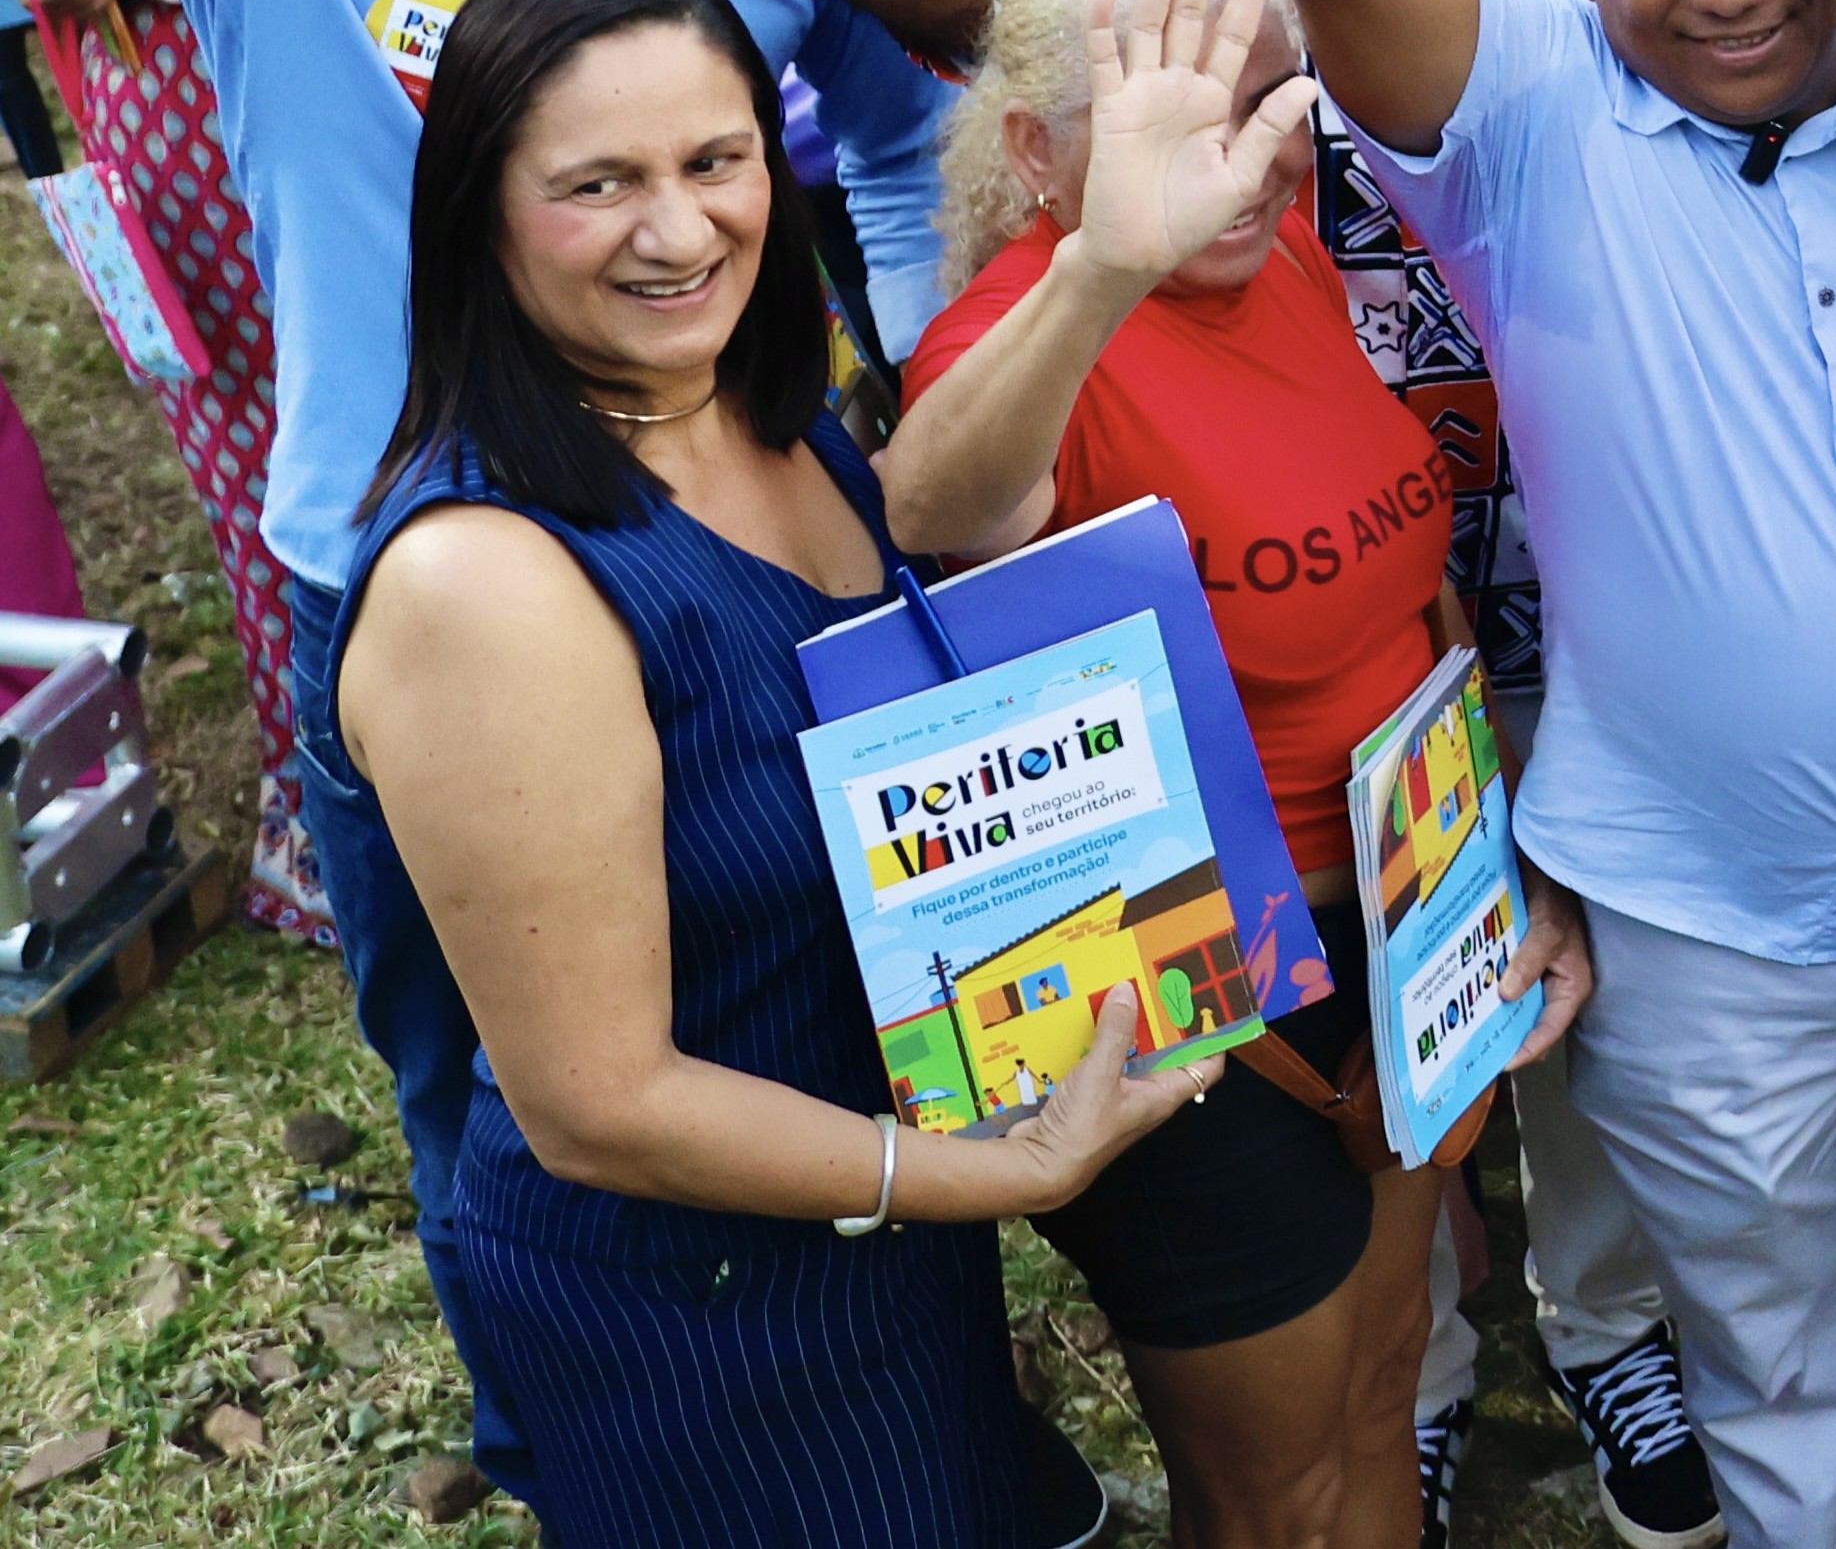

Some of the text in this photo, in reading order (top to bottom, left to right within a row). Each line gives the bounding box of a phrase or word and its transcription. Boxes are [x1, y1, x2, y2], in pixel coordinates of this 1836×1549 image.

[399, 30, 440, 62] Viv
[1196, 452, 1452, 593] LOS ANGE
[877, 717, 1125, 833] Periferia
[1022, 779, 1106, 819] chegou ao
[1025, 786, 1137, 836] seu território:
[888, 810, 1017, 880] Viva
[911, 828, 1128, 919] Fique por dentro e participe
[942, 852, 1111, 926] dessa transformação!
[1460, 902, 1505, 969] Viva
[1416, 941, 1509, 1065] Periferia
